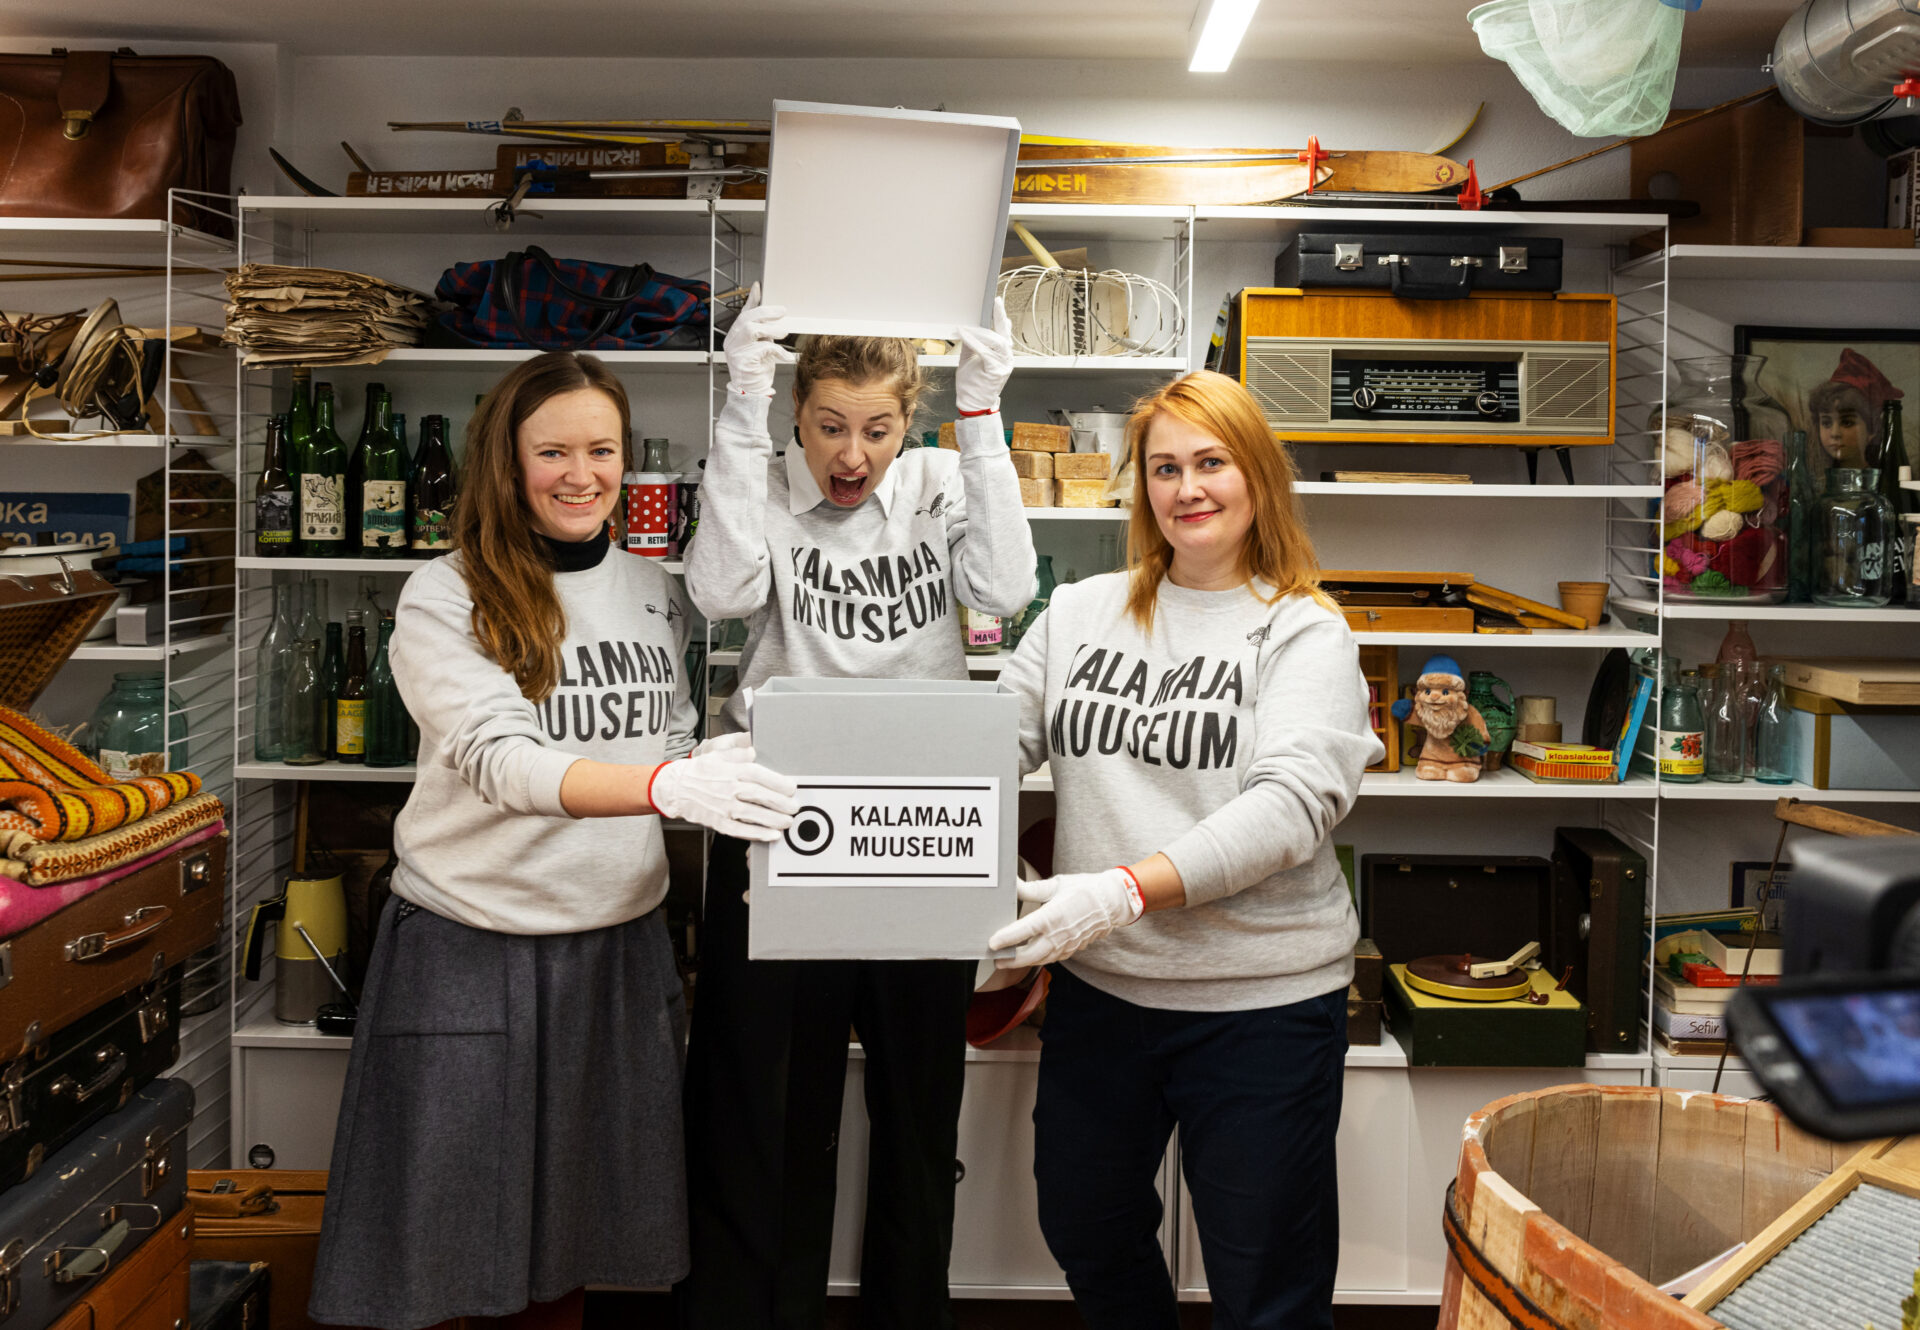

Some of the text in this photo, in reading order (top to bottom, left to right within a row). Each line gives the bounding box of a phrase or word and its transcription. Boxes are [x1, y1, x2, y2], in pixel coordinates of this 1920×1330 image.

[0, 501, 48, 524] ка
[791, 541, 942, 598] KALAMAJA
[793, 578, 947, 644] MUUSEUM
[560, 640, 675, 688] LAMAJA
[537, 690, 676, 742] UUSEUM
[1051, 698, 1238, 770] MUUSEUM
[850, 805, 983, 827] KALAMAJA
[850, 836, 974, 857] MUUSEUM
